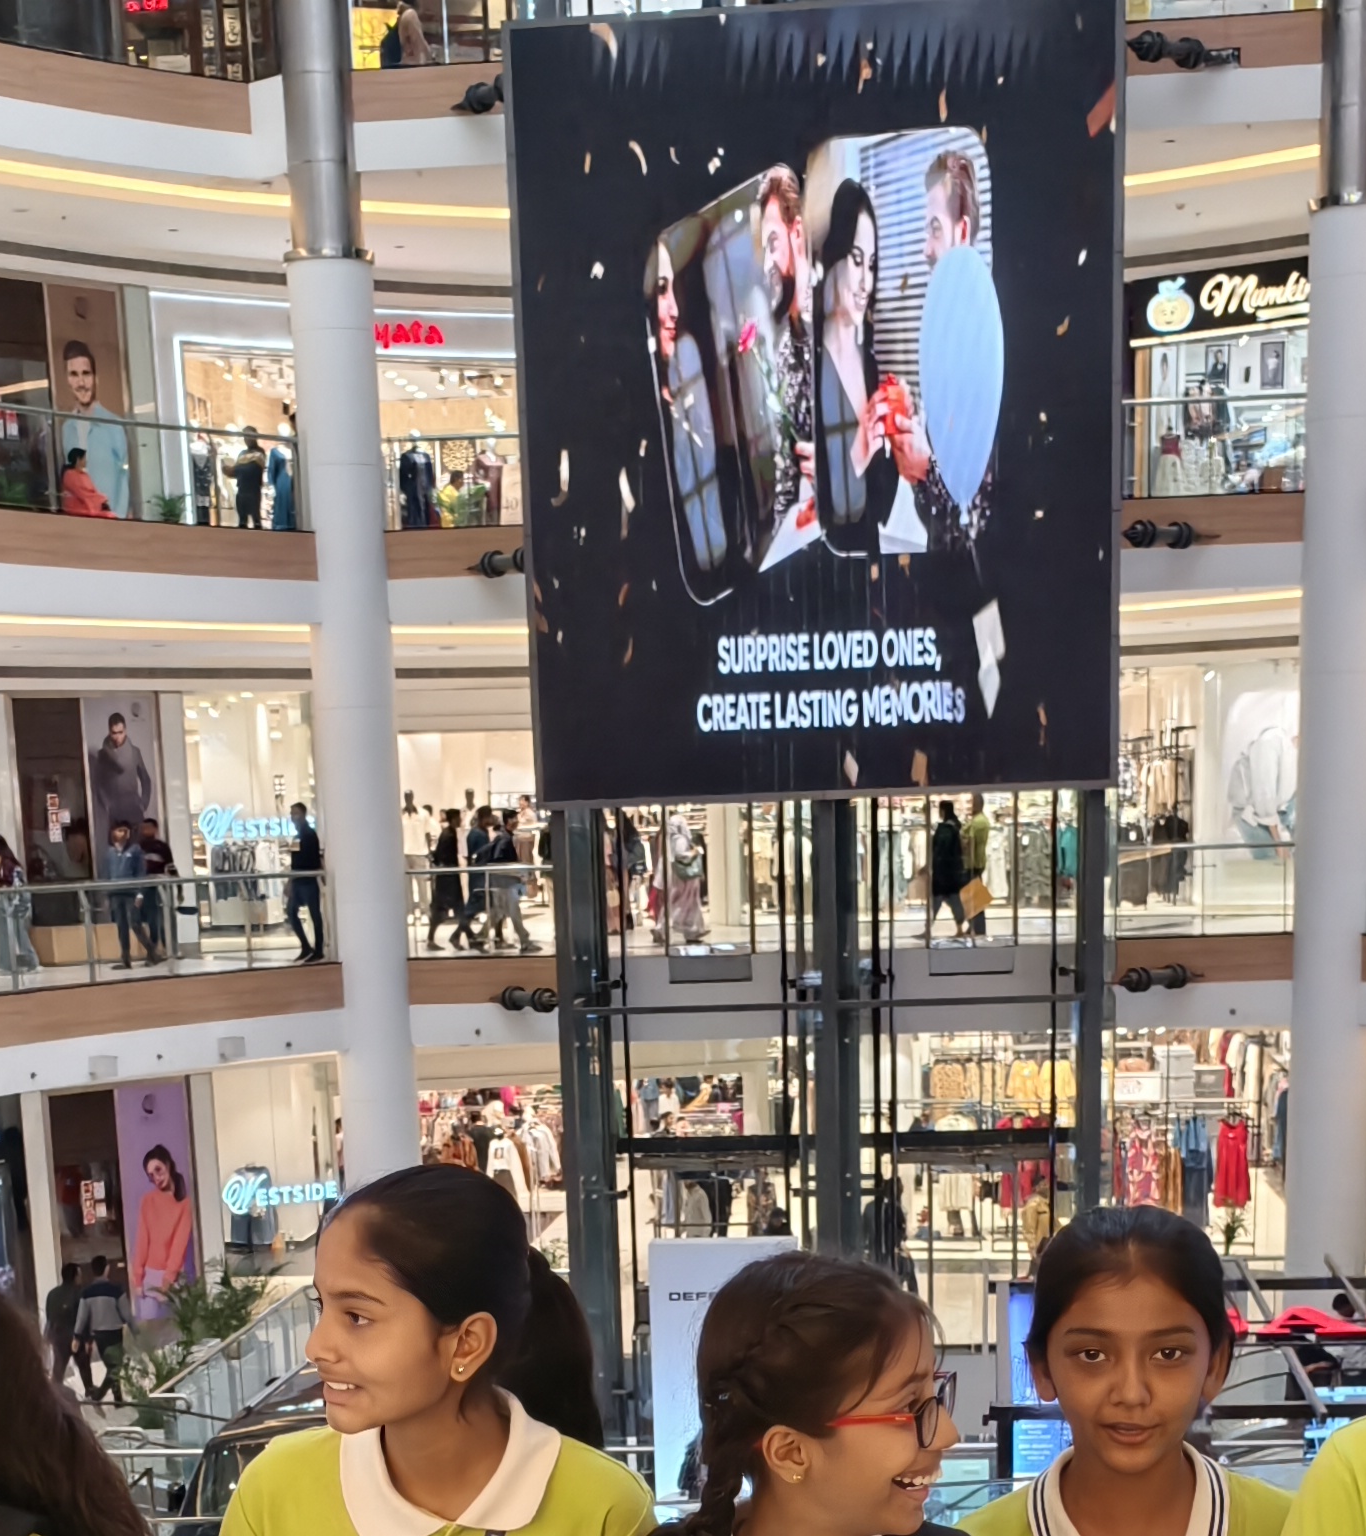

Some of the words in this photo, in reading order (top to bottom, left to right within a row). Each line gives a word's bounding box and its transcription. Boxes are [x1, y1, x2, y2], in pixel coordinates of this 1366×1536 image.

[717, 633, 809, 675] SURPRISE
[811, 631, 878, 672] LOVED
[881, 627, 943, 673] ONES,
[696, 693, 771, 734] CREATE
[773, 689, 859, 730] LASTING
[861, 681, 966, 727] MEMORIES
[222, 1171, 339, 1215] WESTSIDE
